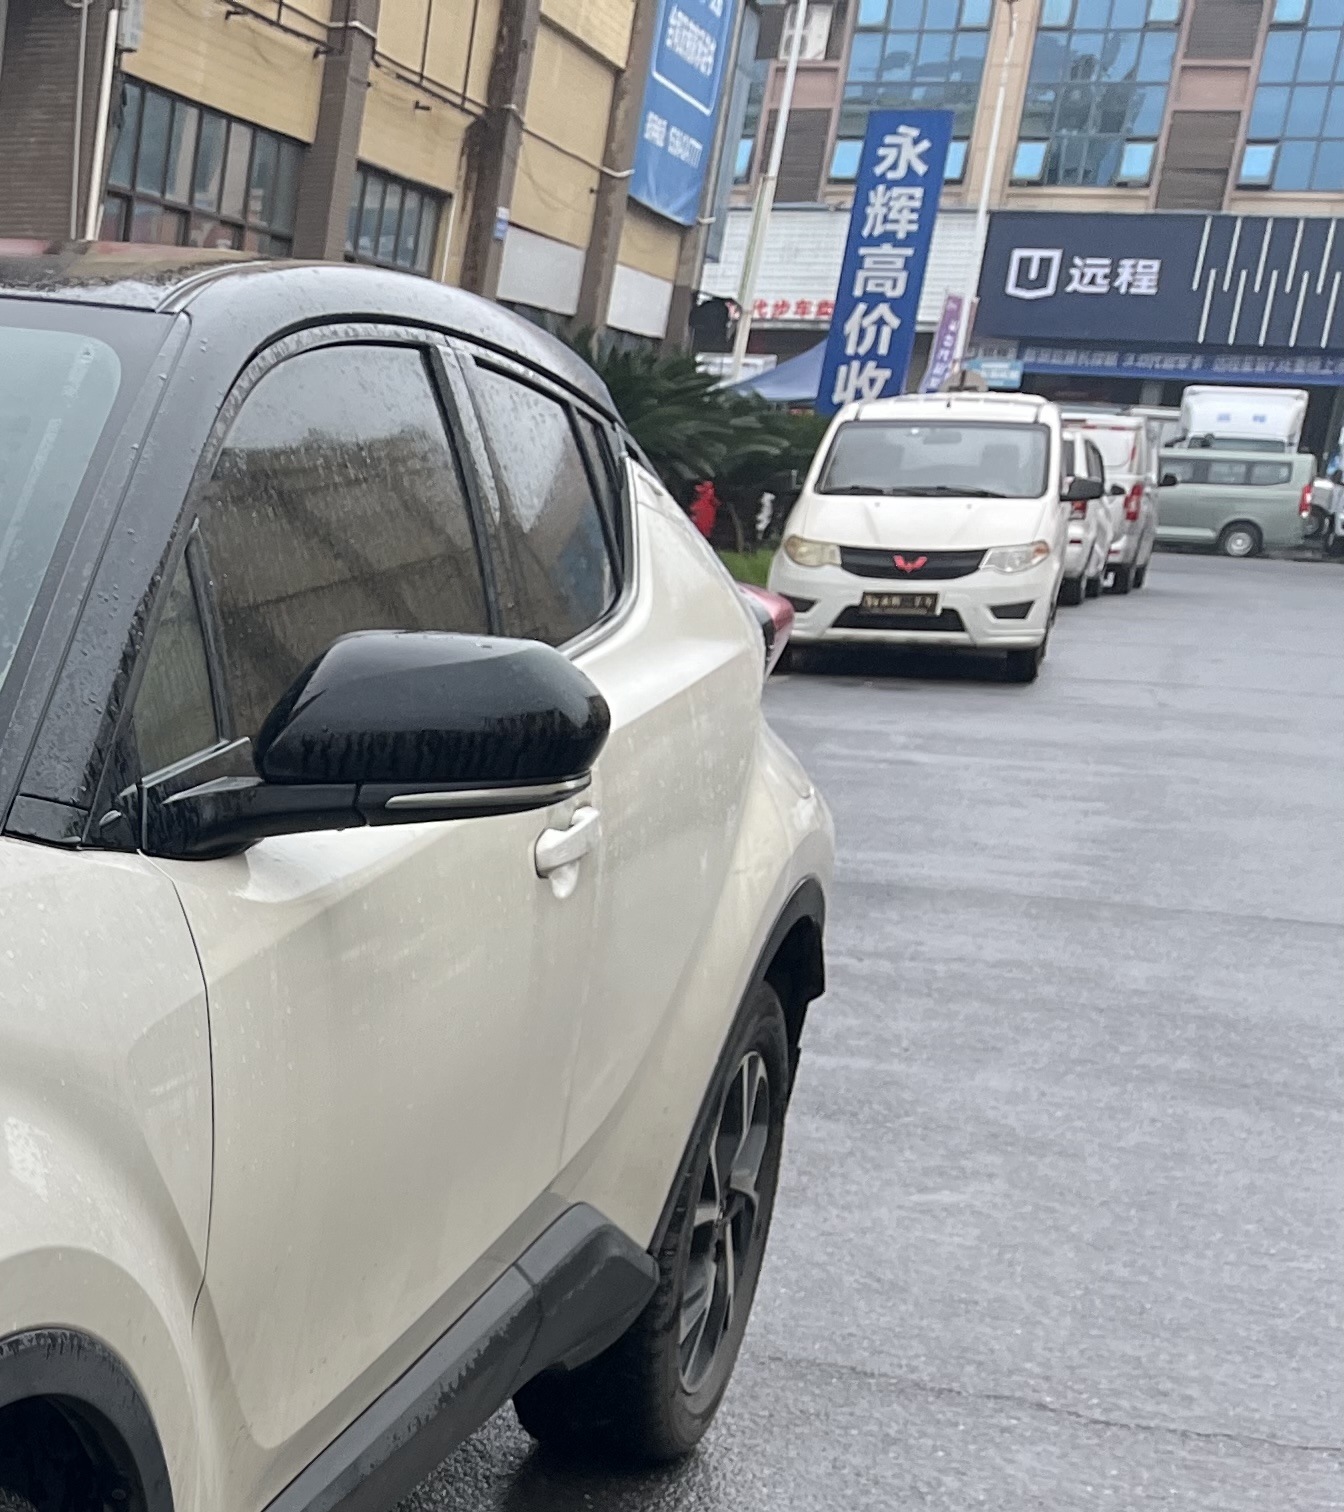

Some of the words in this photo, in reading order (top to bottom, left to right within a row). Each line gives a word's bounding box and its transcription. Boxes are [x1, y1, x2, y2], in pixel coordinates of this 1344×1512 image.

[831, 124, 932, 405] 永辉高价收
[1065, 256, 1161, 295] 远程
